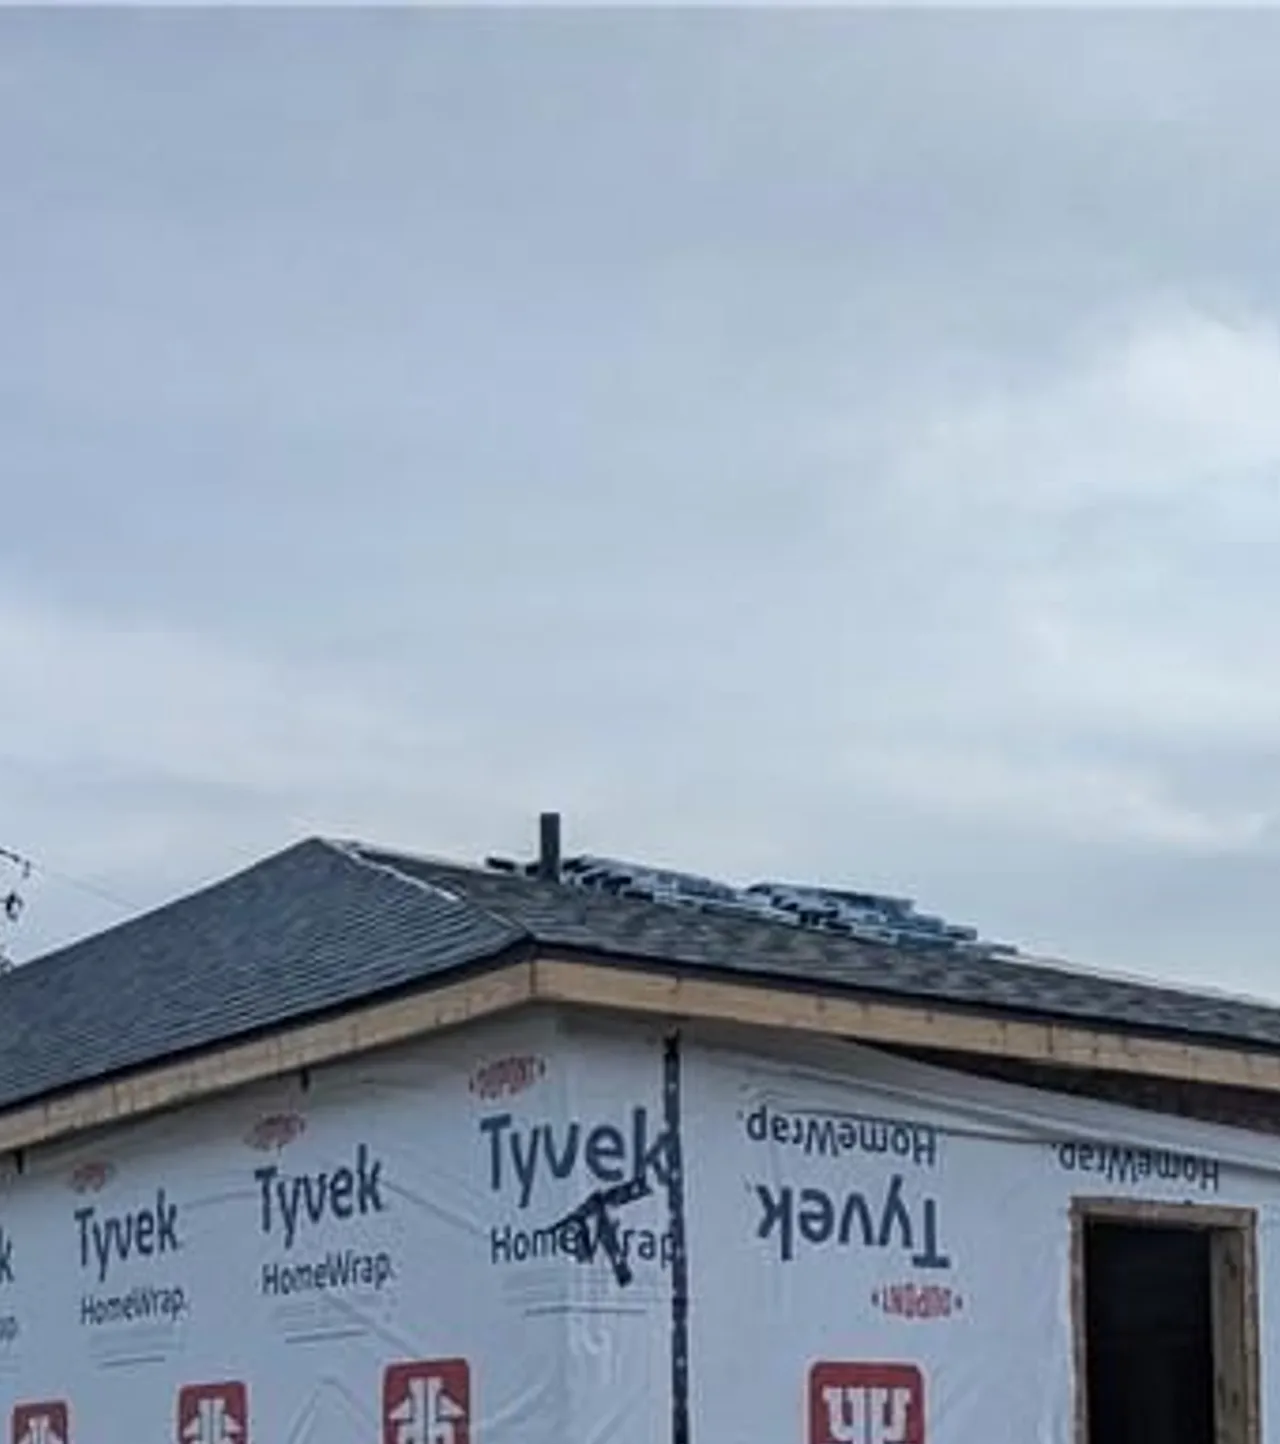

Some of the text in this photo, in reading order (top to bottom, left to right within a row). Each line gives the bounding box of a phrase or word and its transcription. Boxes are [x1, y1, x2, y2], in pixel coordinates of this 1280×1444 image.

[480, 1106, 671, 1209] Tyvek
[746, 1105, 937, 1166] HomeWrap
[74, 1188, 178, 1283] Tyvek
[255, 1143, 383, 1250] Tyvek
[756, 1174, 951, 1268] Tyvek
[81, 1286, 185, 1325] HomeWrap
[263, 1251, 390, 1295] HomeWrap
